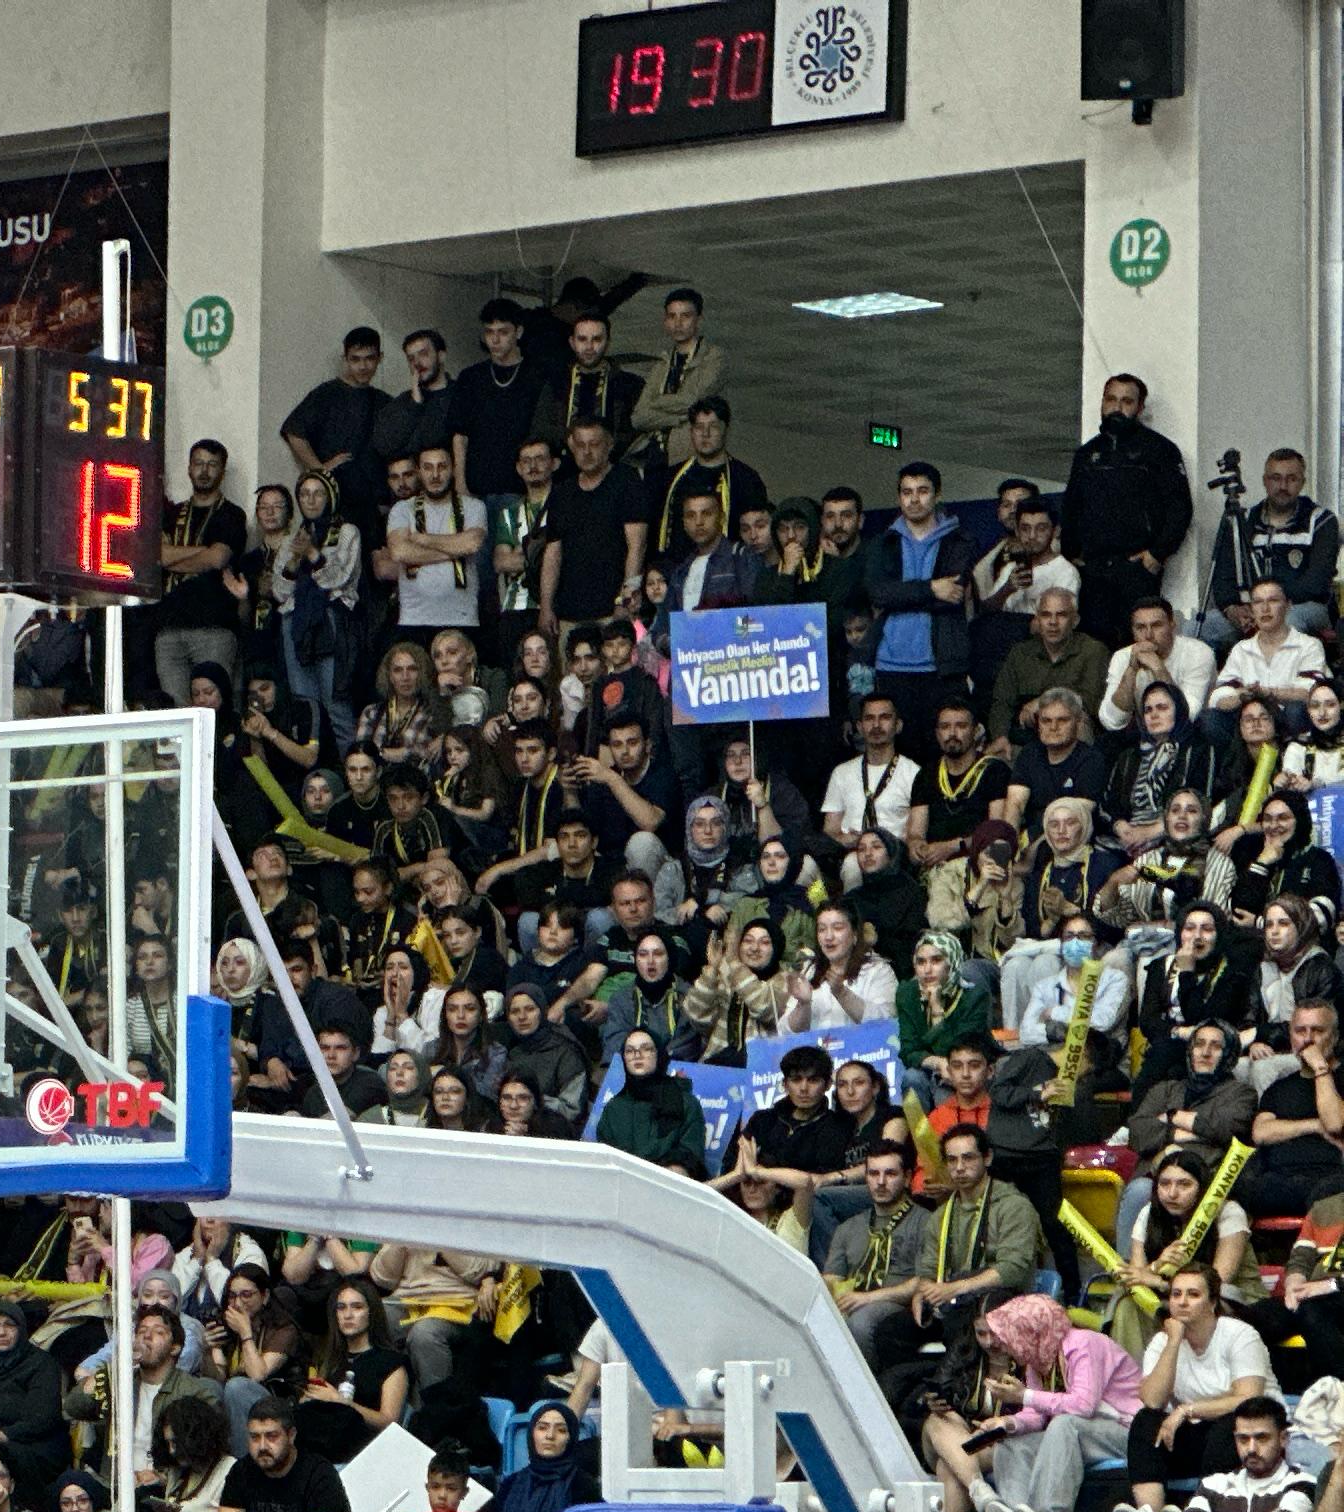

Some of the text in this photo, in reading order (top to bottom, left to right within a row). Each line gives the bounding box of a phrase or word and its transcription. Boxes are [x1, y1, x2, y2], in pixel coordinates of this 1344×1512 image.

[1119, 228, 1162, 263] D2
[190, 306, 226, 339] D3
[78, 460, 141, 580] 12
[727, 643, 751, 657] Olan
[752, 640, 770, 655] Her
[773, 635, 810, 652] Anında
[681, 651, 821, 708] Yanında!
[1077, 974, 1098, 1019] KONYA
[77, 1080, 165, 1128] TBF
[1212, 1154, 1245, 1199] KONYA
